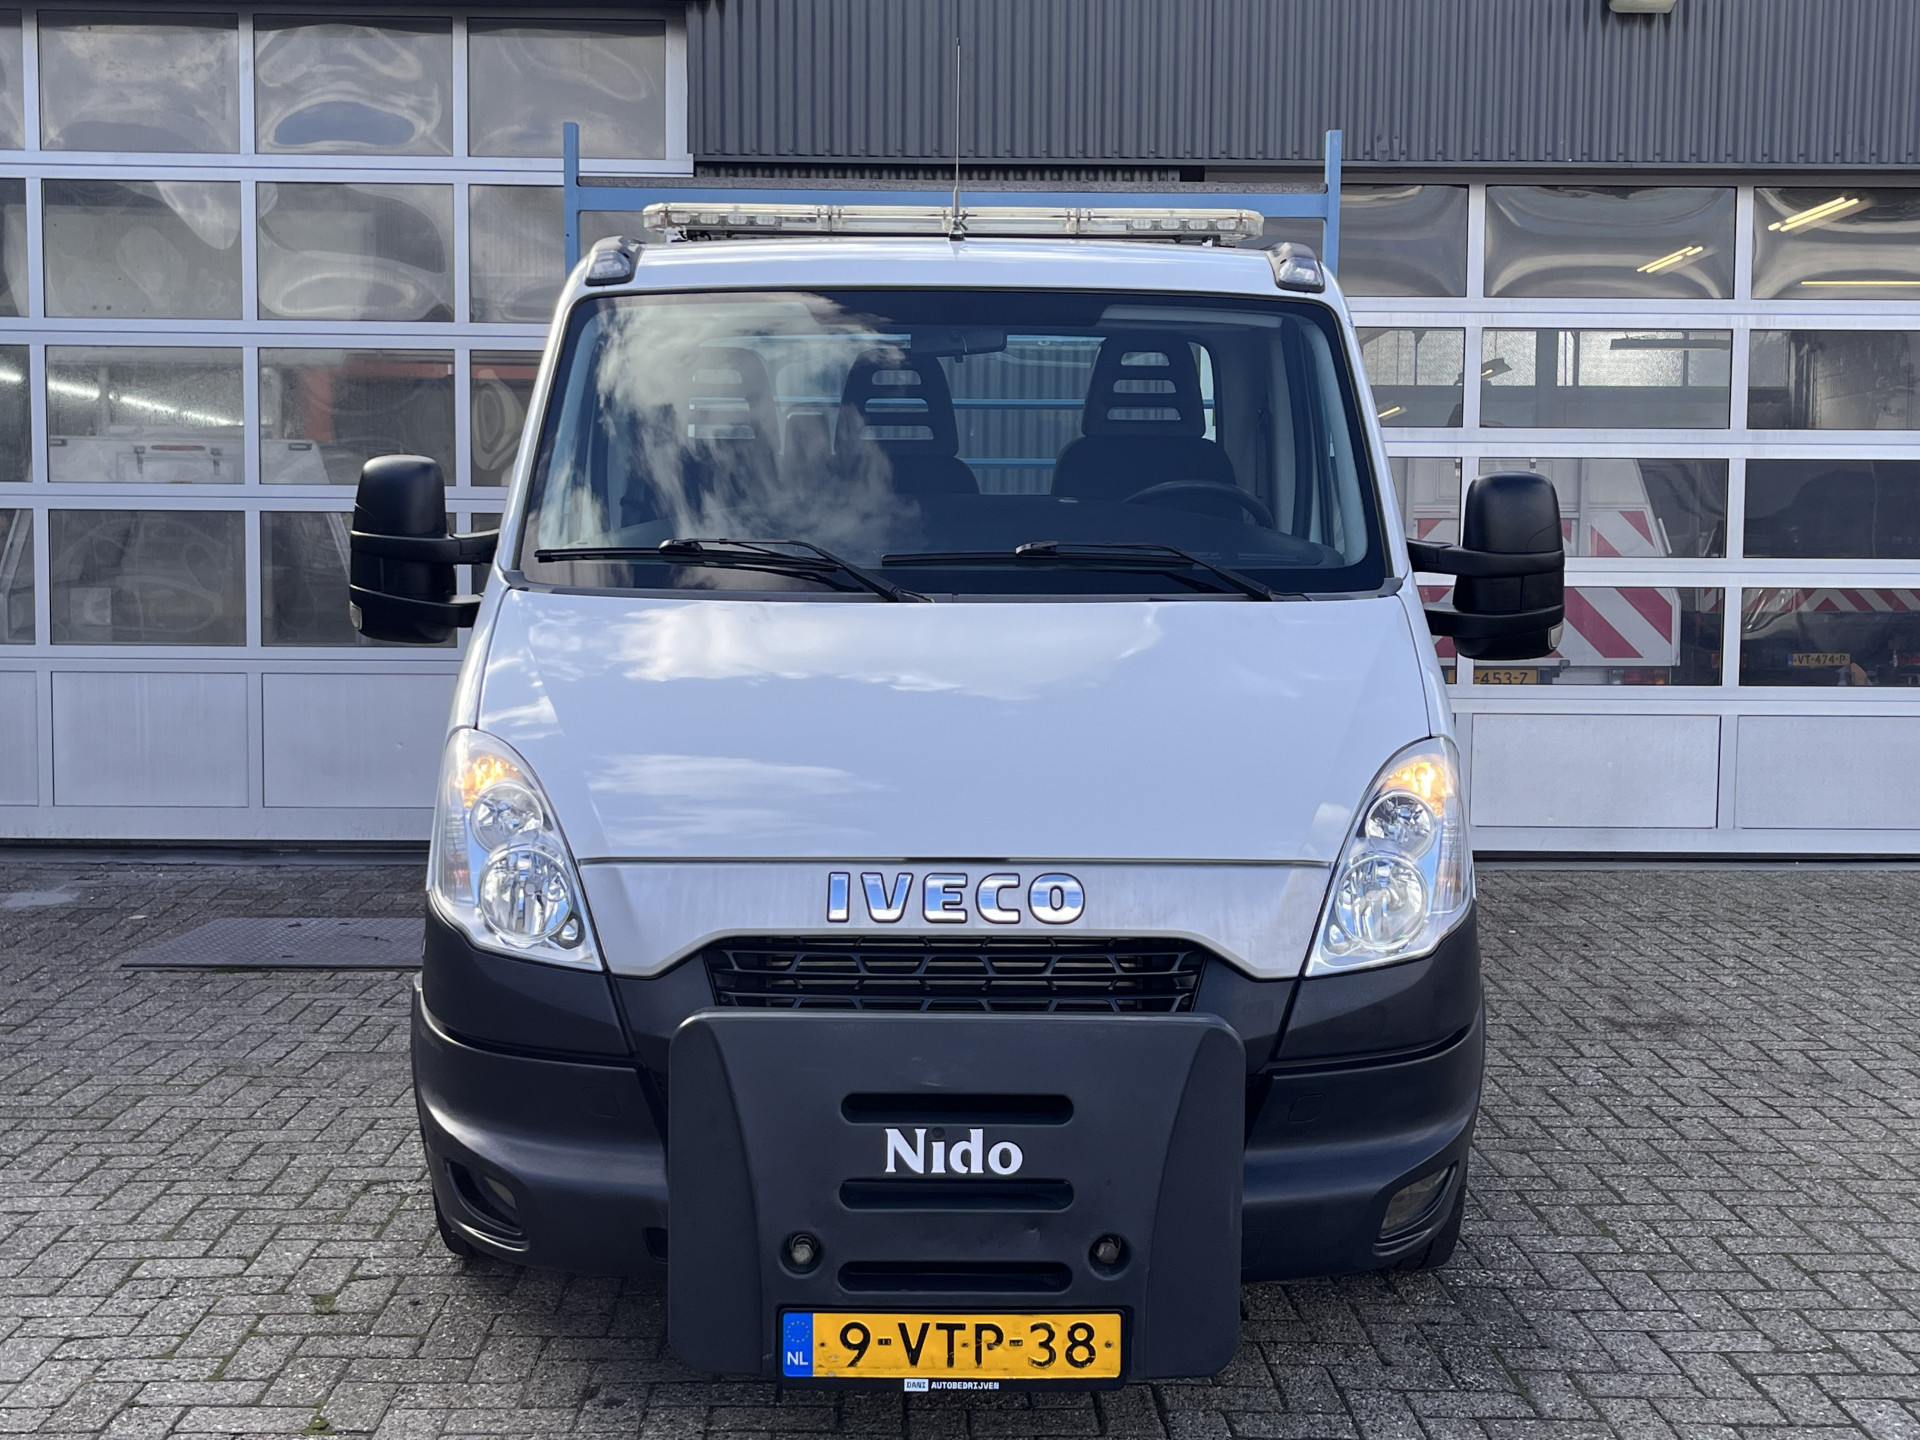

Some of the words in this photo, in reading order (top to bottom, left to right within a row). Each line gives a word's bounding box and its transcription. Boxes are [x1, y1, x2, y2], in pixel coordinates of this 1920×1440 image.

[827, 872, 1085, 924] IVECO
[885, 1127, 1023, 1175] Nido
[787, 1351, 809, 1366] NL
[839, 1321, 1097, 1369] 9-VTP-38
[906, 1381, 927, 1389] DANI
[931, 1382, 999, 1390] AUTOBEDRIJVEN
